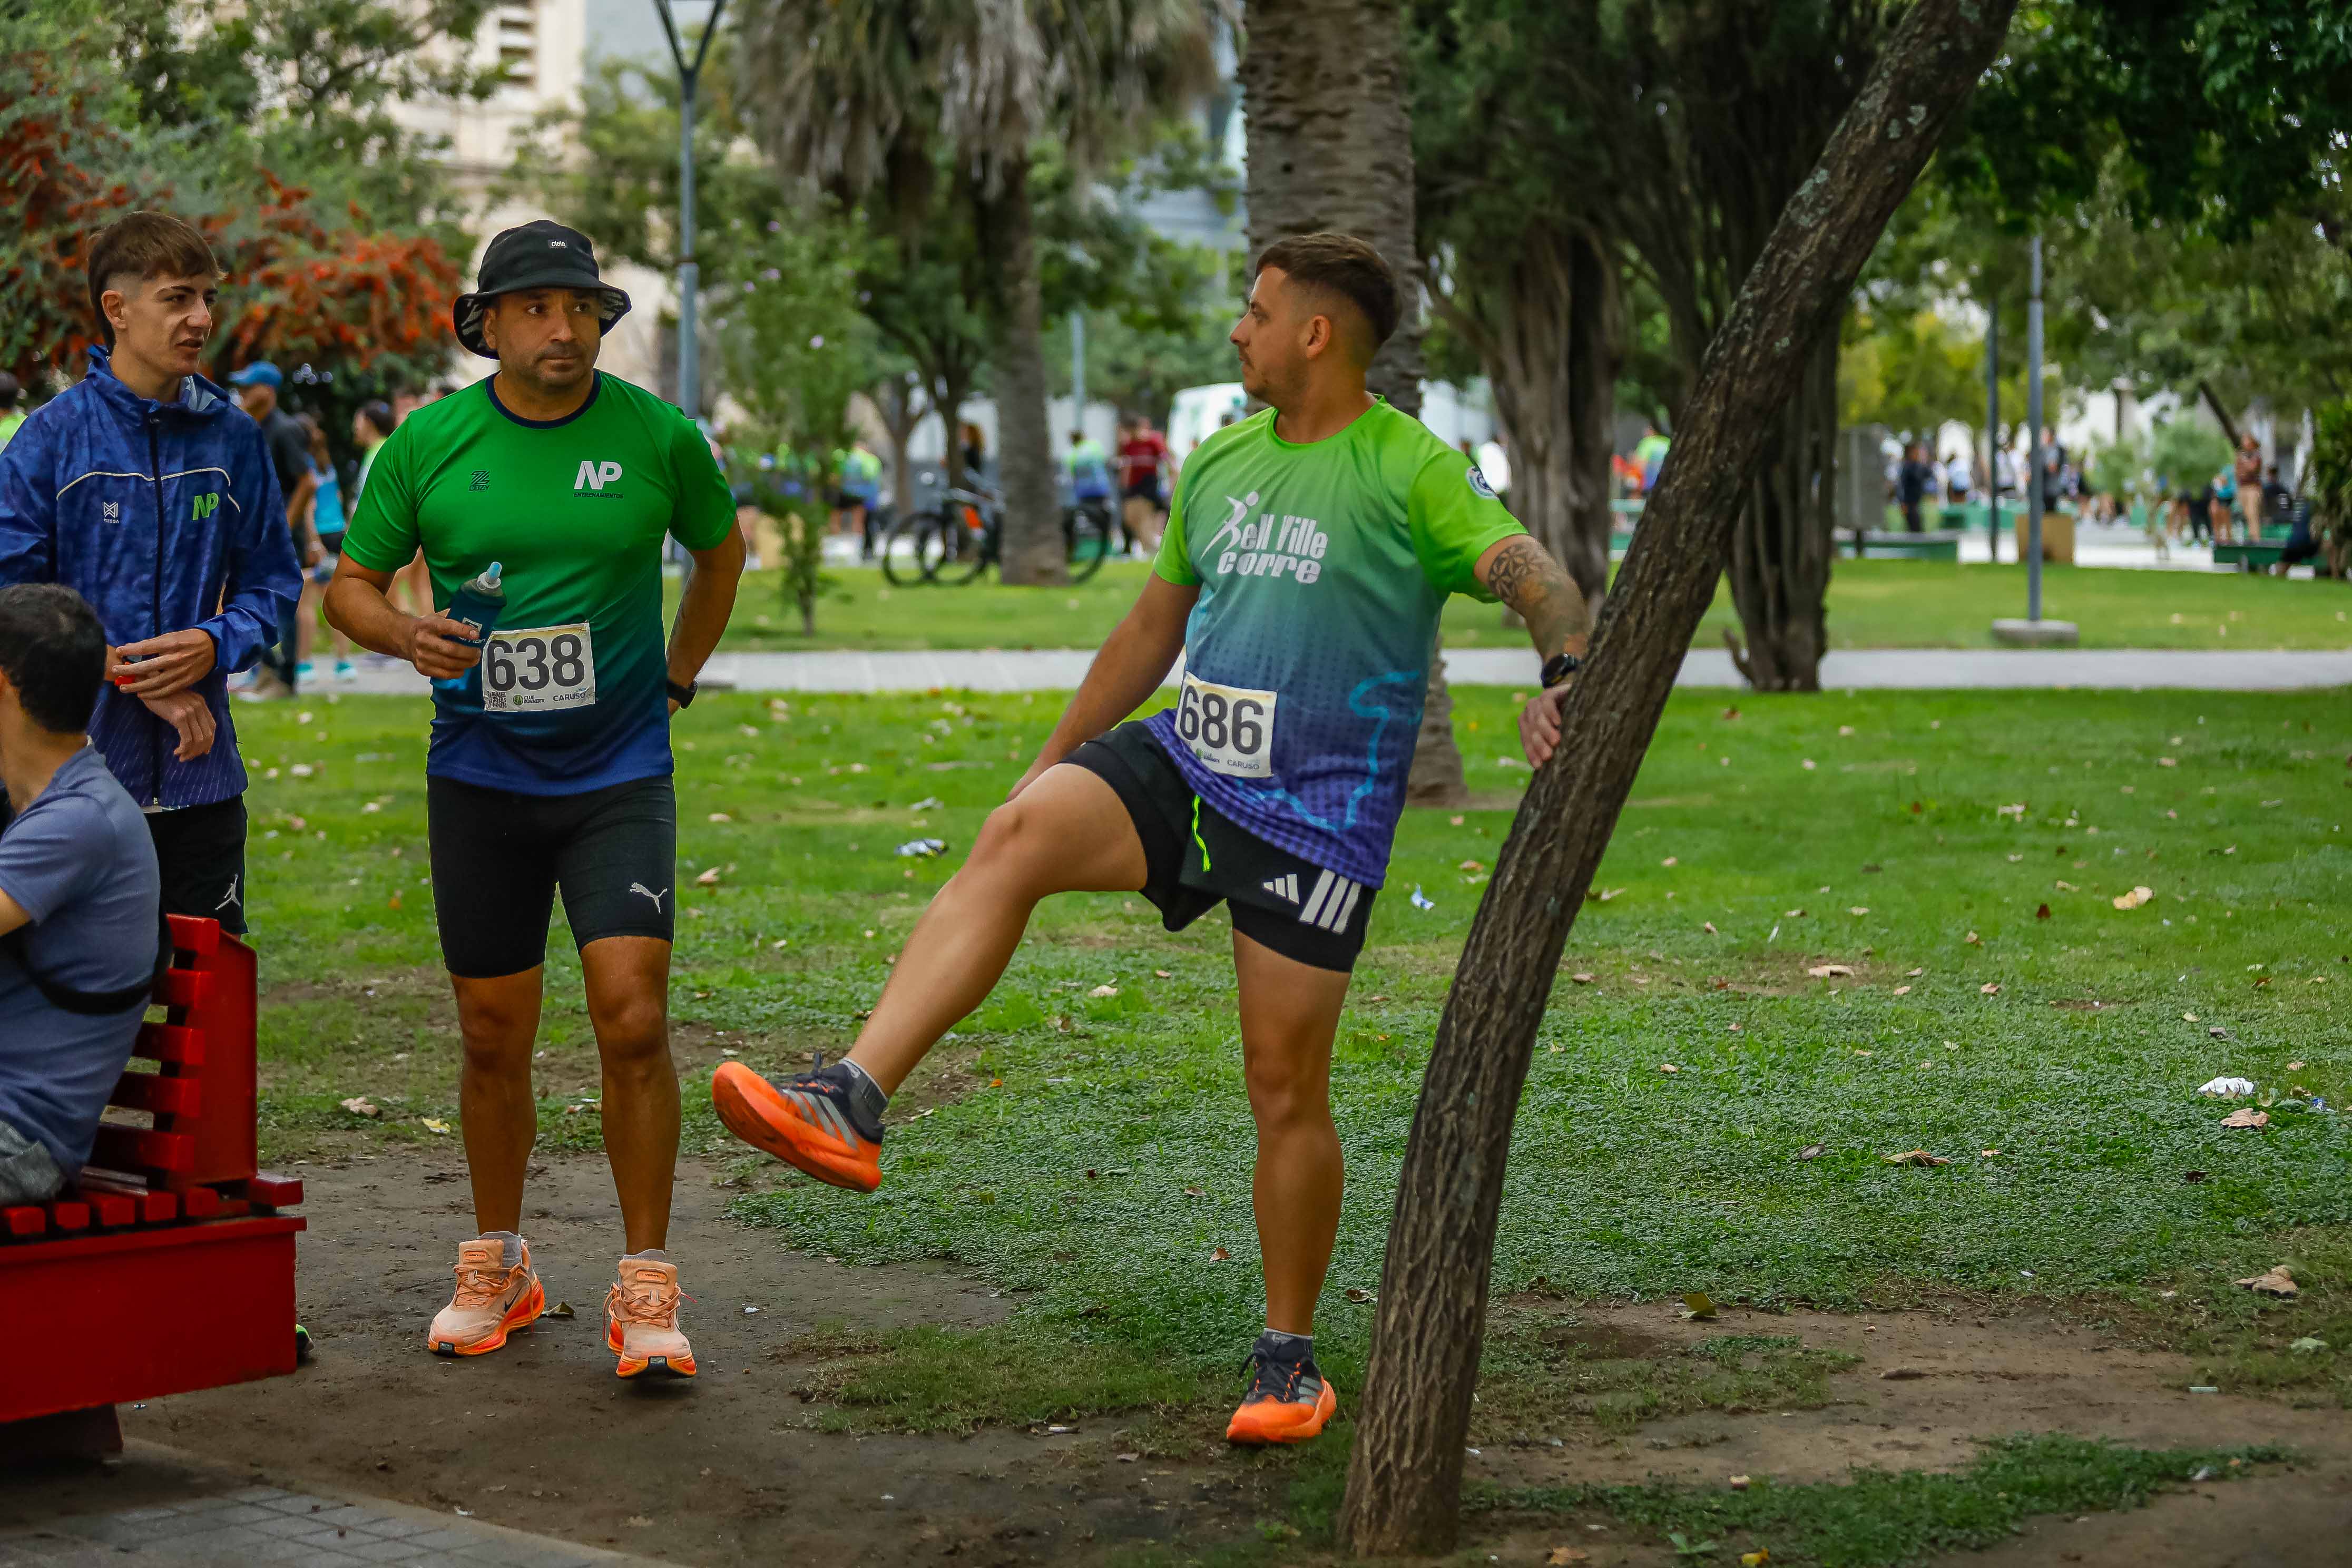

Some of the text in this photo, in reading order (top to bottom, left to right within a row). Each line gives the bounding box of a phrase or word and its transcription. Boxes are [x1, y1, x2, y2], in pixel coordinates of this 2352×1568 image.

[573, 460, 622, 490] NP
[192, 493, 219, 521] NP
[1217, 552, 1321, 584] corre
[487, 634, 585, 691] 638
[553, 692, 586, 701] CARUSO
[1180, 685, 1264, 754] 686
[1227, 759, 1260, 770] CARUSO
